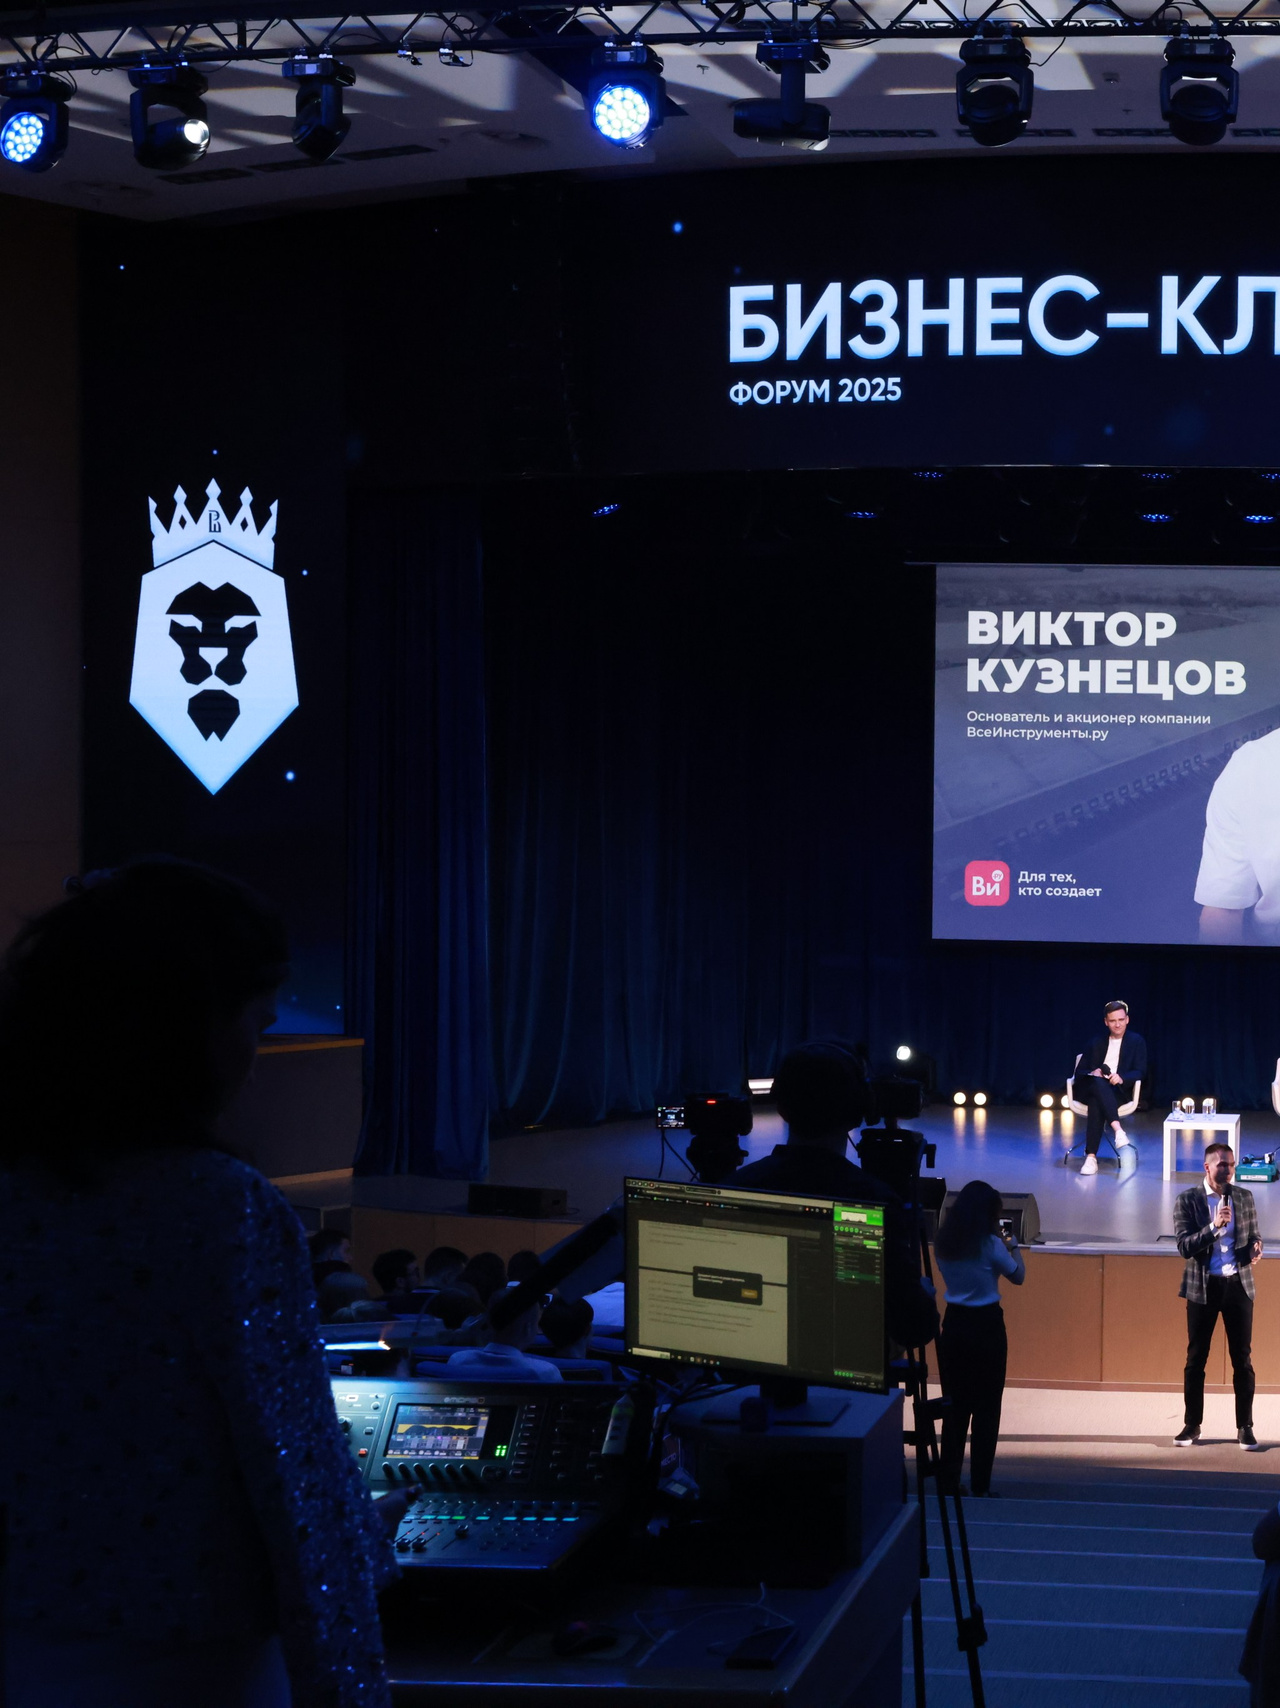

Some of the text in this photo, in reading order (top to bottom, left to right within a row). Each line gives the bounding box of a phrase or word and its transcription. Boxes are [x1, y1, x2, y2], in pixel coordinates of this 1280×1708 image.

[730, 378, 901, 405] ФОРУМ 2025
[968, 611, 1176, 646] ВИКТОР
[967, 659, 1246, 700] КУЗНЕЦОВ
[966, 710, 1211, 726] Основатель и акционер компании
[966, 726, 1110, 742] ВсеИнструменты.ру
[1017, 870, 1077, 885] Для тех,
[1018, 886, 1103, 898] кто создает
